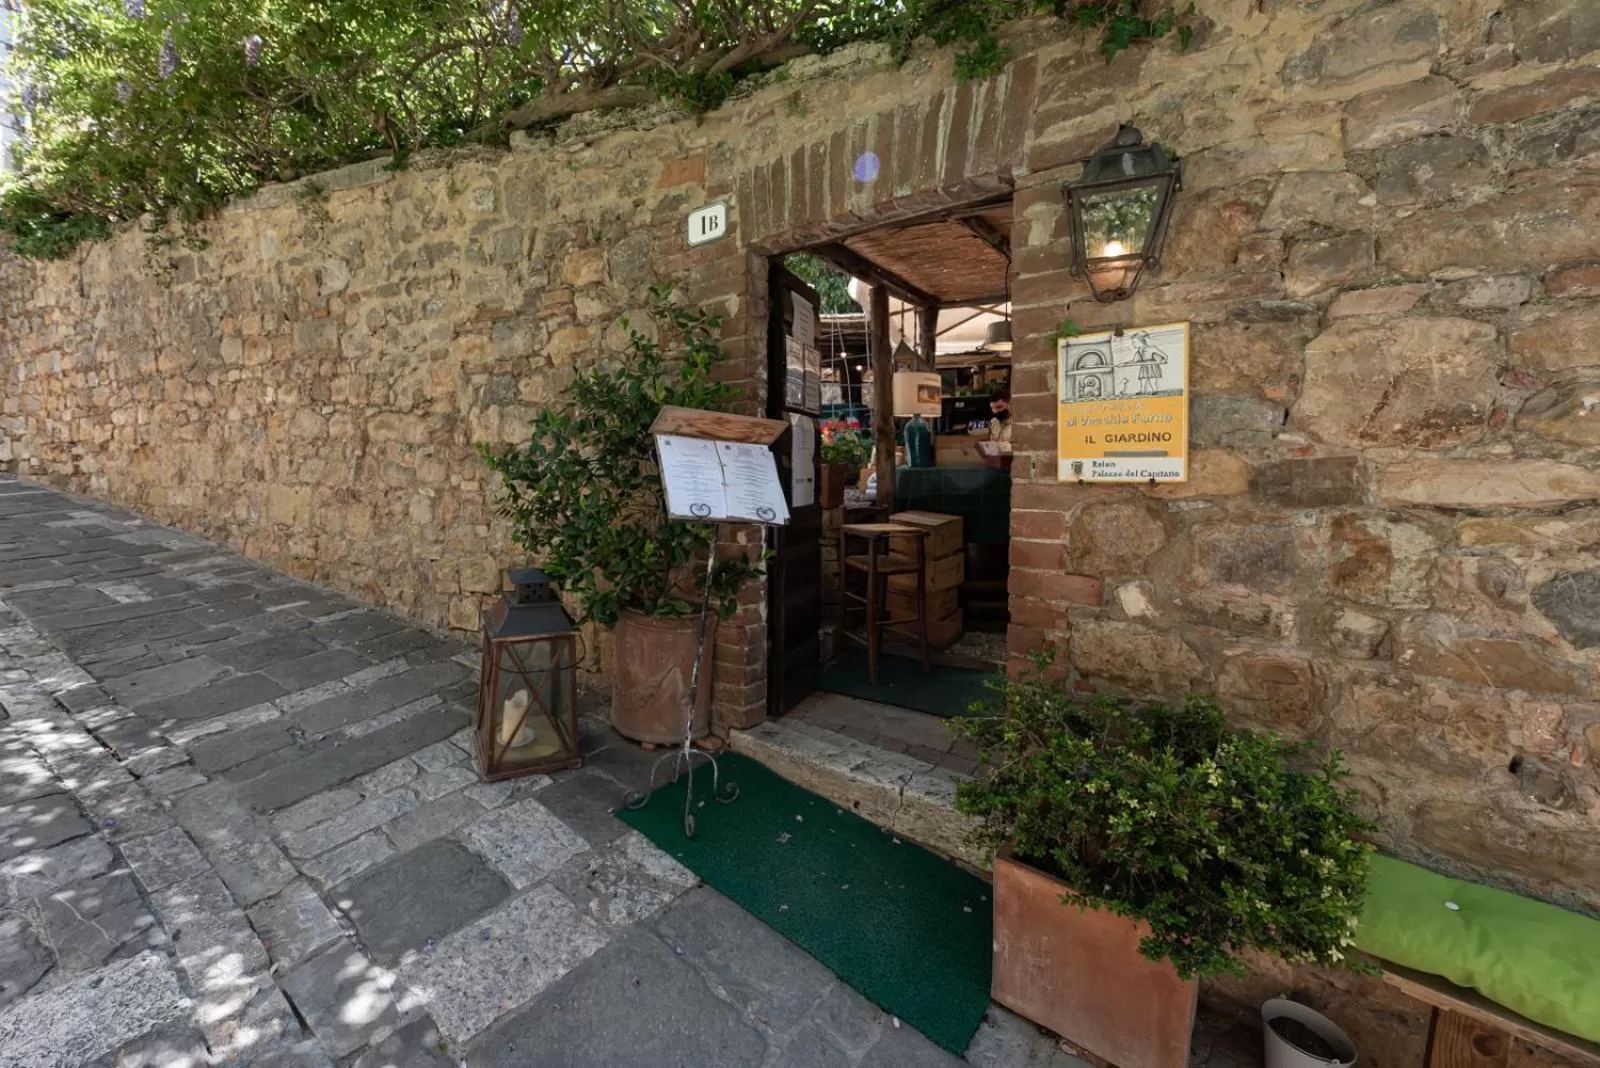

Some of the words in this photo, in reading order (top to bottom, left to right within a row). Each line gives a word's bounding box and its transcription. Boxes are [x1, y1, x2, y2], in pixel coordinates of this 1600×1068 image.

[701, 215, 719, 235] 1B
[1085, 435, 1096, 444] IL
[1104, 432, 1172, 443] GIARDINO
[1140, 470, 1180, 478] Capitano
